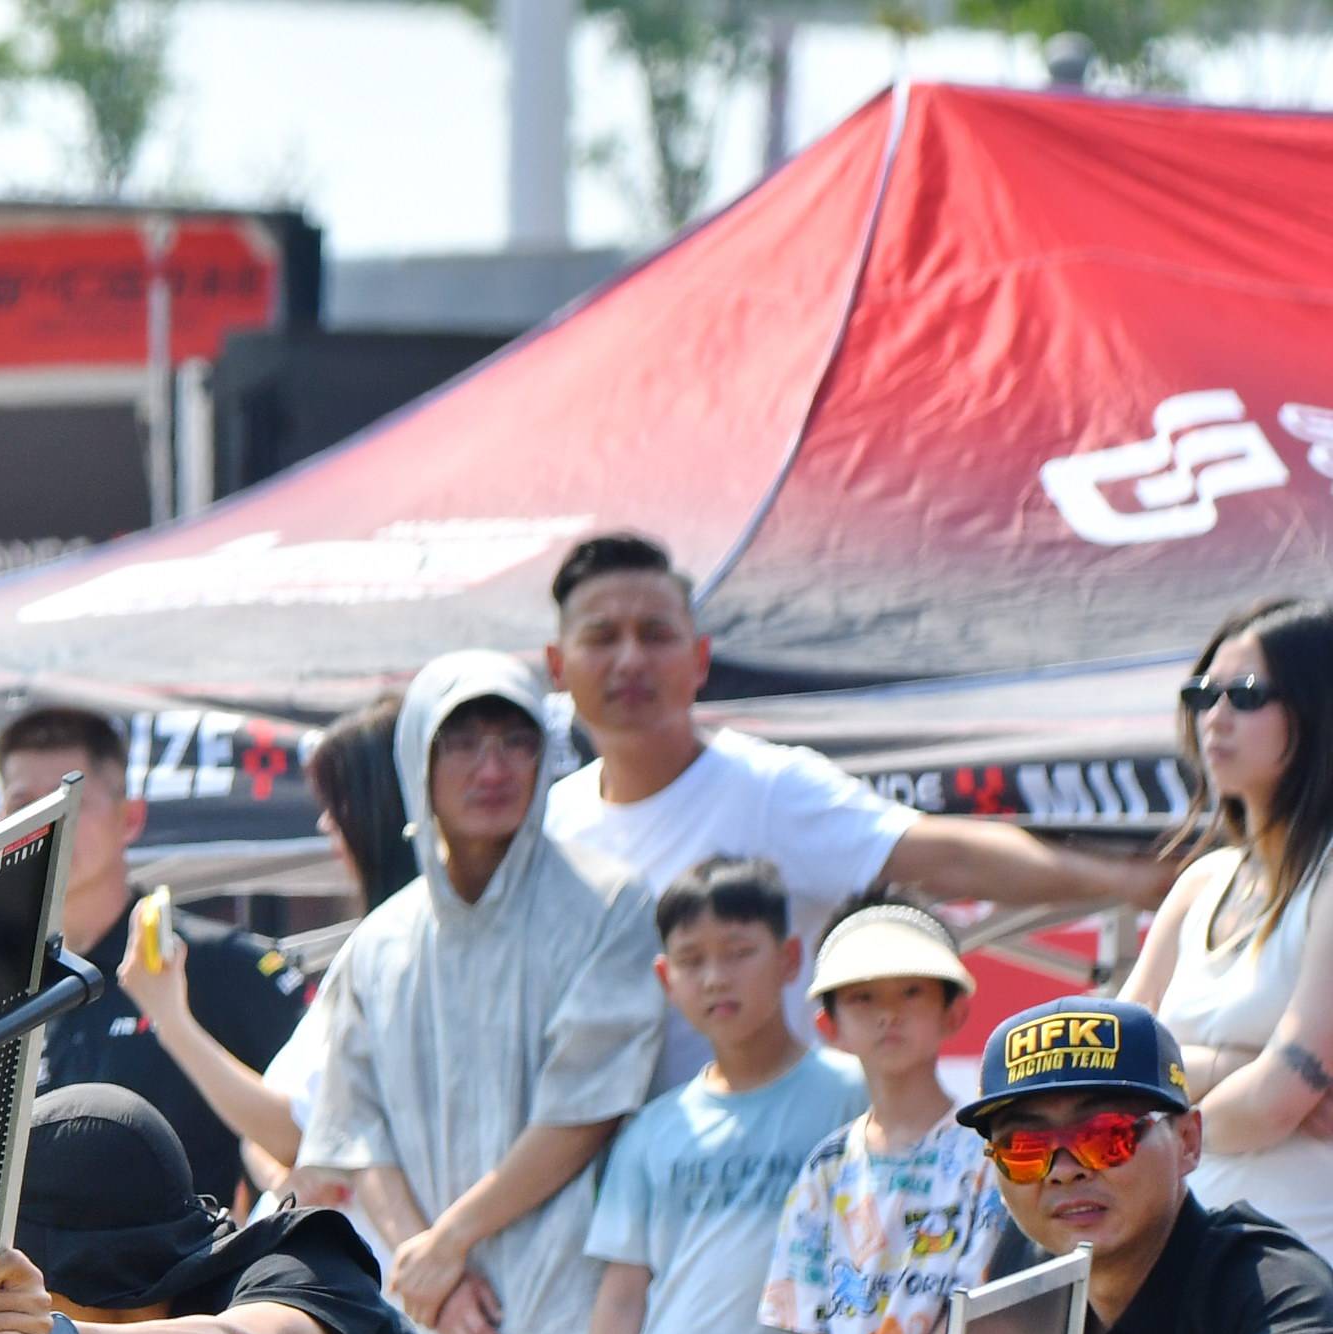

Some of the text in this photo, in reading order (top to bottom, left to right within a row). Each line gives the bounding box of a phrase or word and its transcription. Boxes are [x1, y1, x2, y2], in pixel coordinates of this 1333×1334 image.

[1011, 1018, 1104, 1060] HFK
[1006, 1050, 1118, 1085] RACING TEAM
